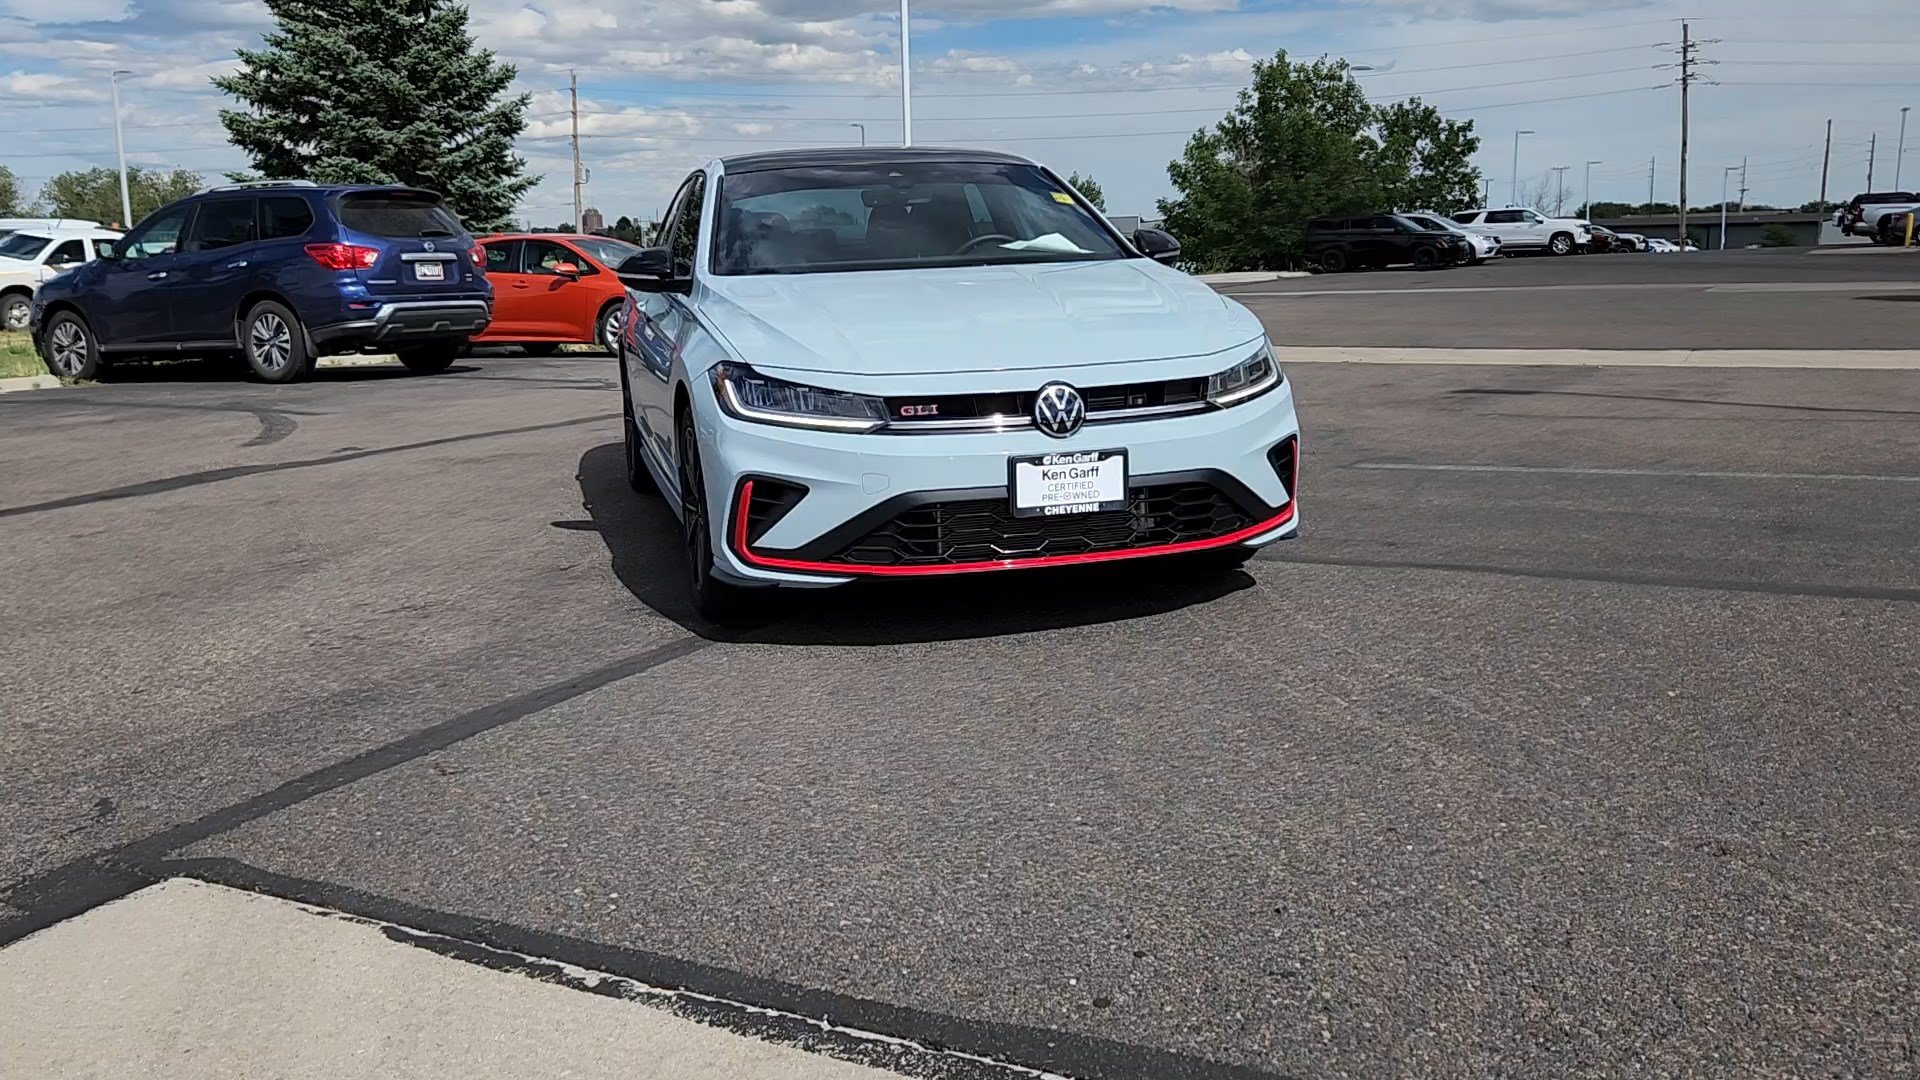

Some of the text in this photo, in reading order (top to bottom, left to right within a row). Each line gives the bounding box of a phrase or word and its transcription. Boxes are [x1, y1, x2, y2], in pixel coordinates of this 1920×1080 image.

[900, 404, 939, 416] GLI
[1052, 452, 1099, 464] Ken Garff
[1042, 466, 1100, 481] Ken Garff
[1047, 481, 1094, 493] CERTIFIED
[1044, 503, 1100, 515] CHEYENNE
